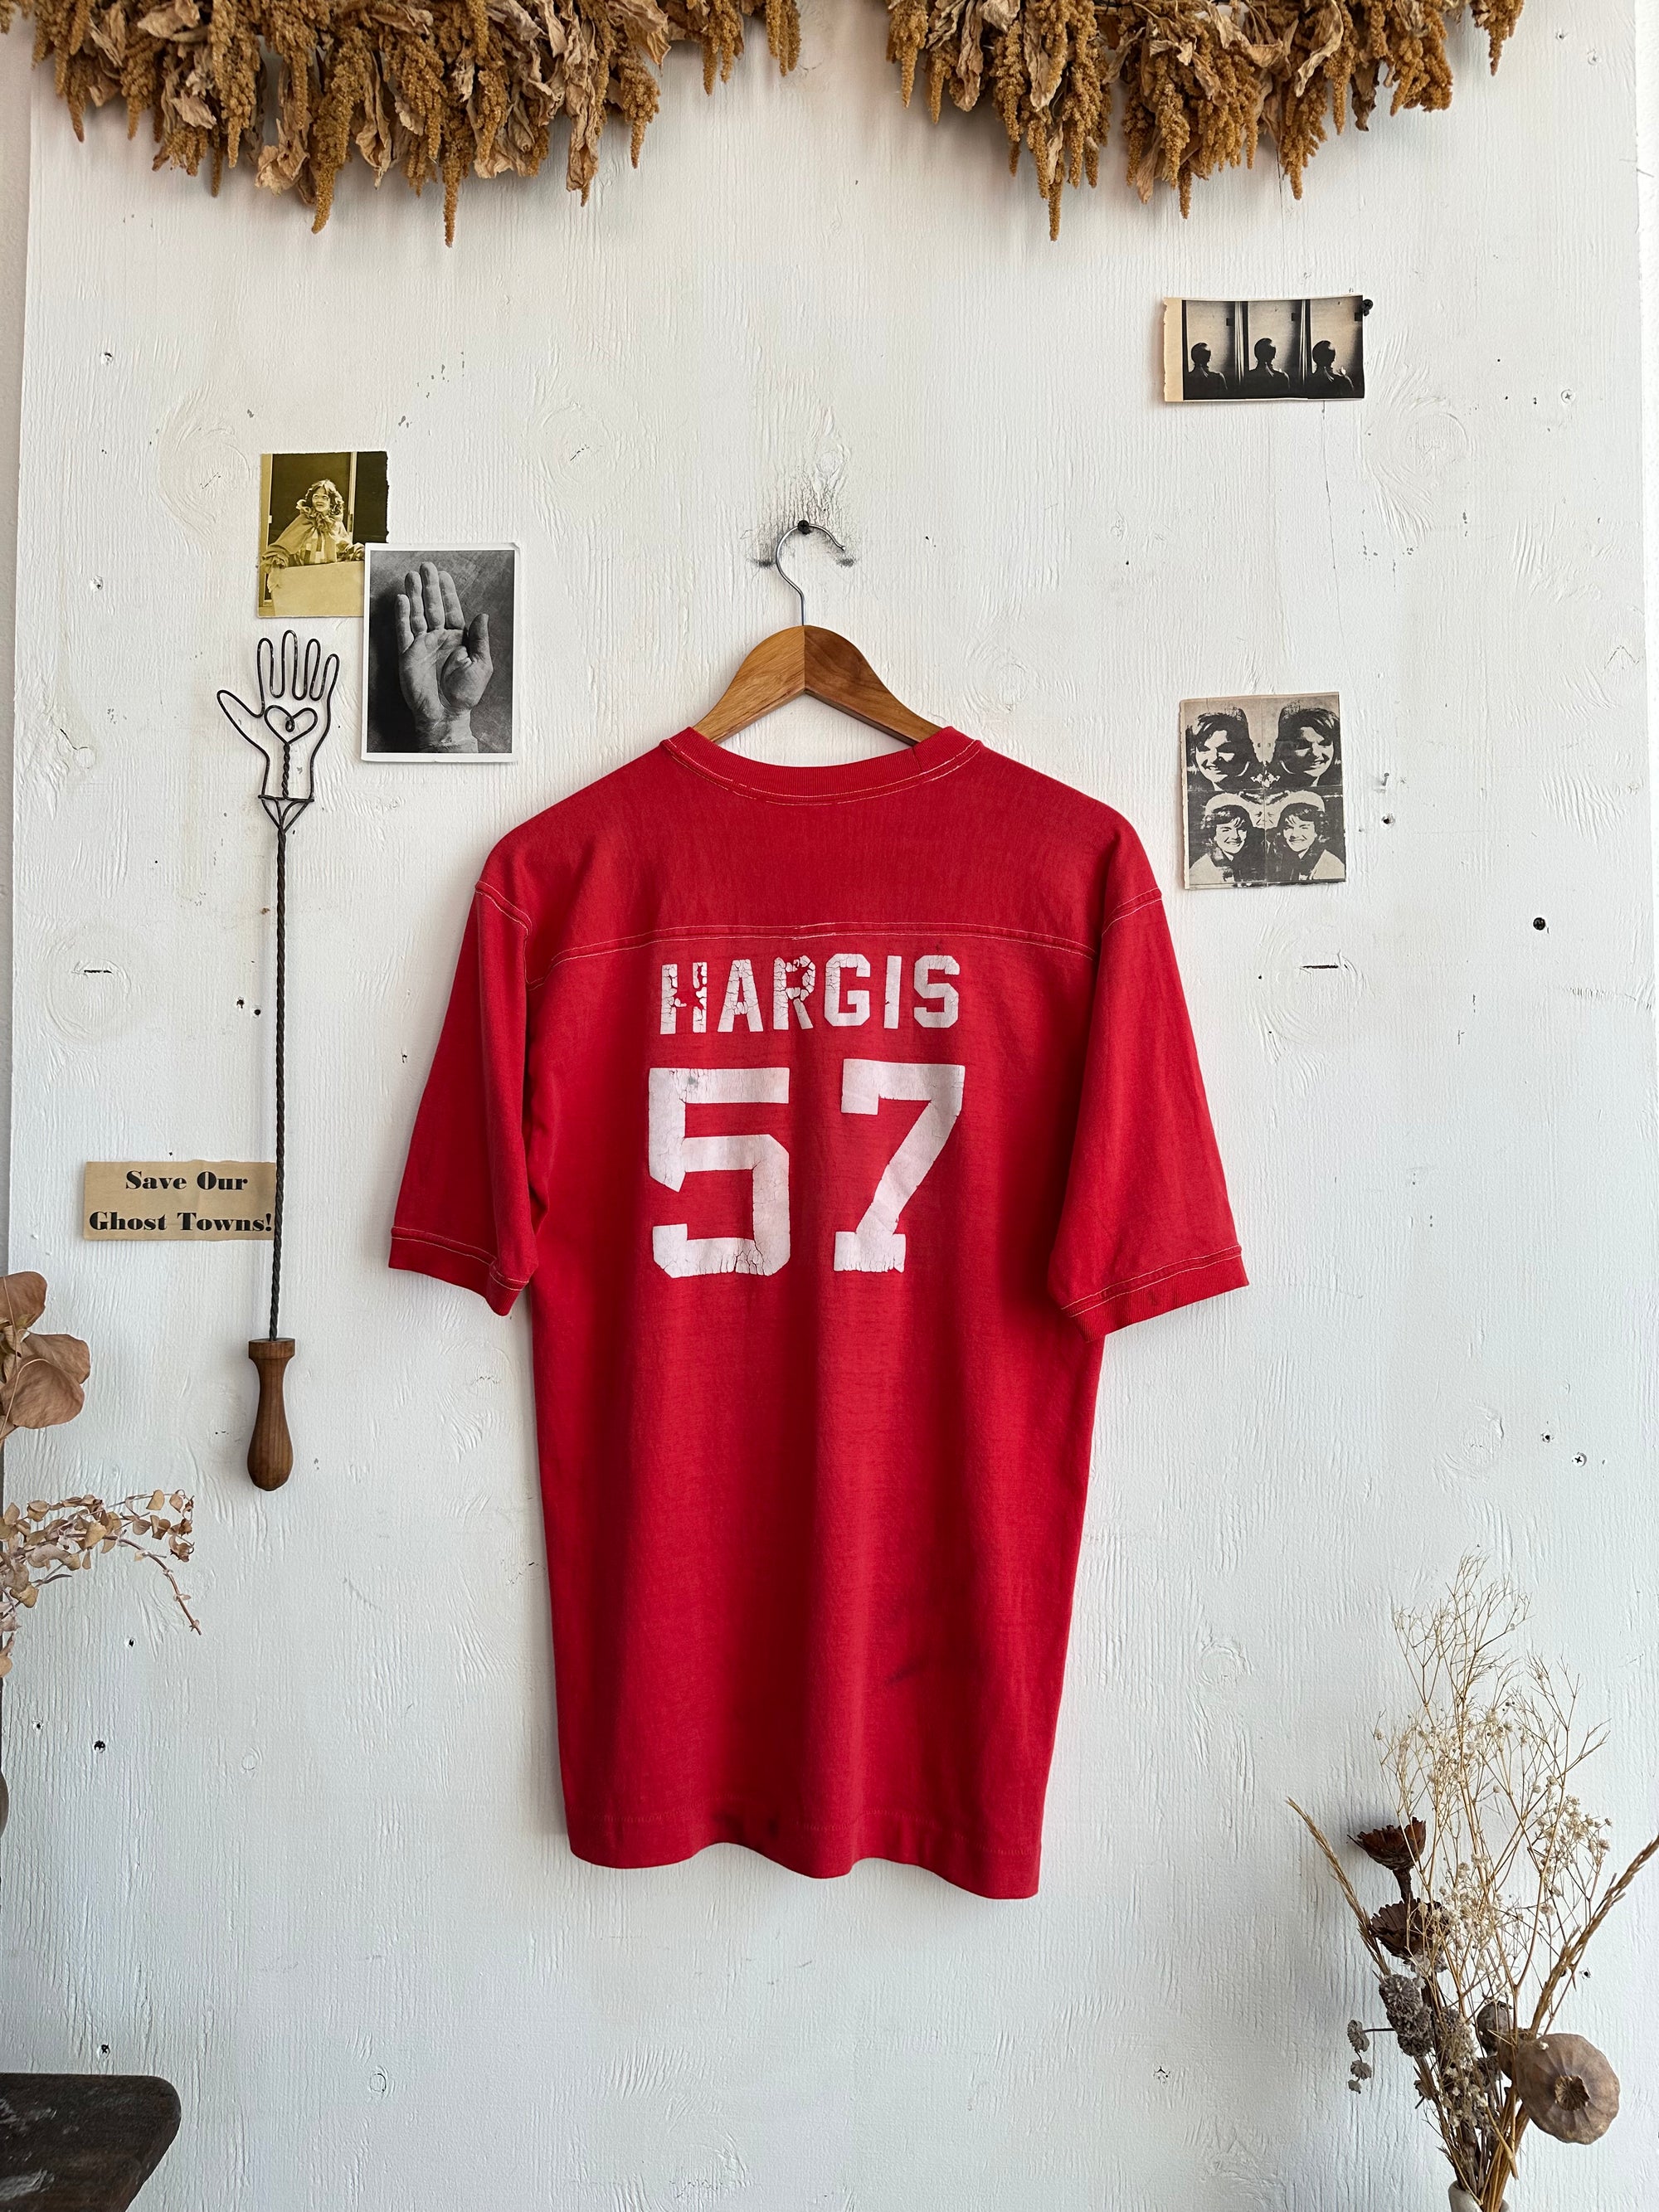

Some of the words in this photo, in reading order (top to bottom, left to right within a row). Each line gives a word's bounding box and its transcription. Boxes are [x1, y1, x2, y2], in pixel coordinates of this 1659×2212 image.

[659, 953, 961, 1035] HARGIS
[125, 1169, 187, 1190] Save
[197, 1170, 249, 1190] Our
[648, 1058, 966, 1279] 57
[89, 1211, 168, 1231] Ghost
[177, 1212, 272, 1232] Towns!
